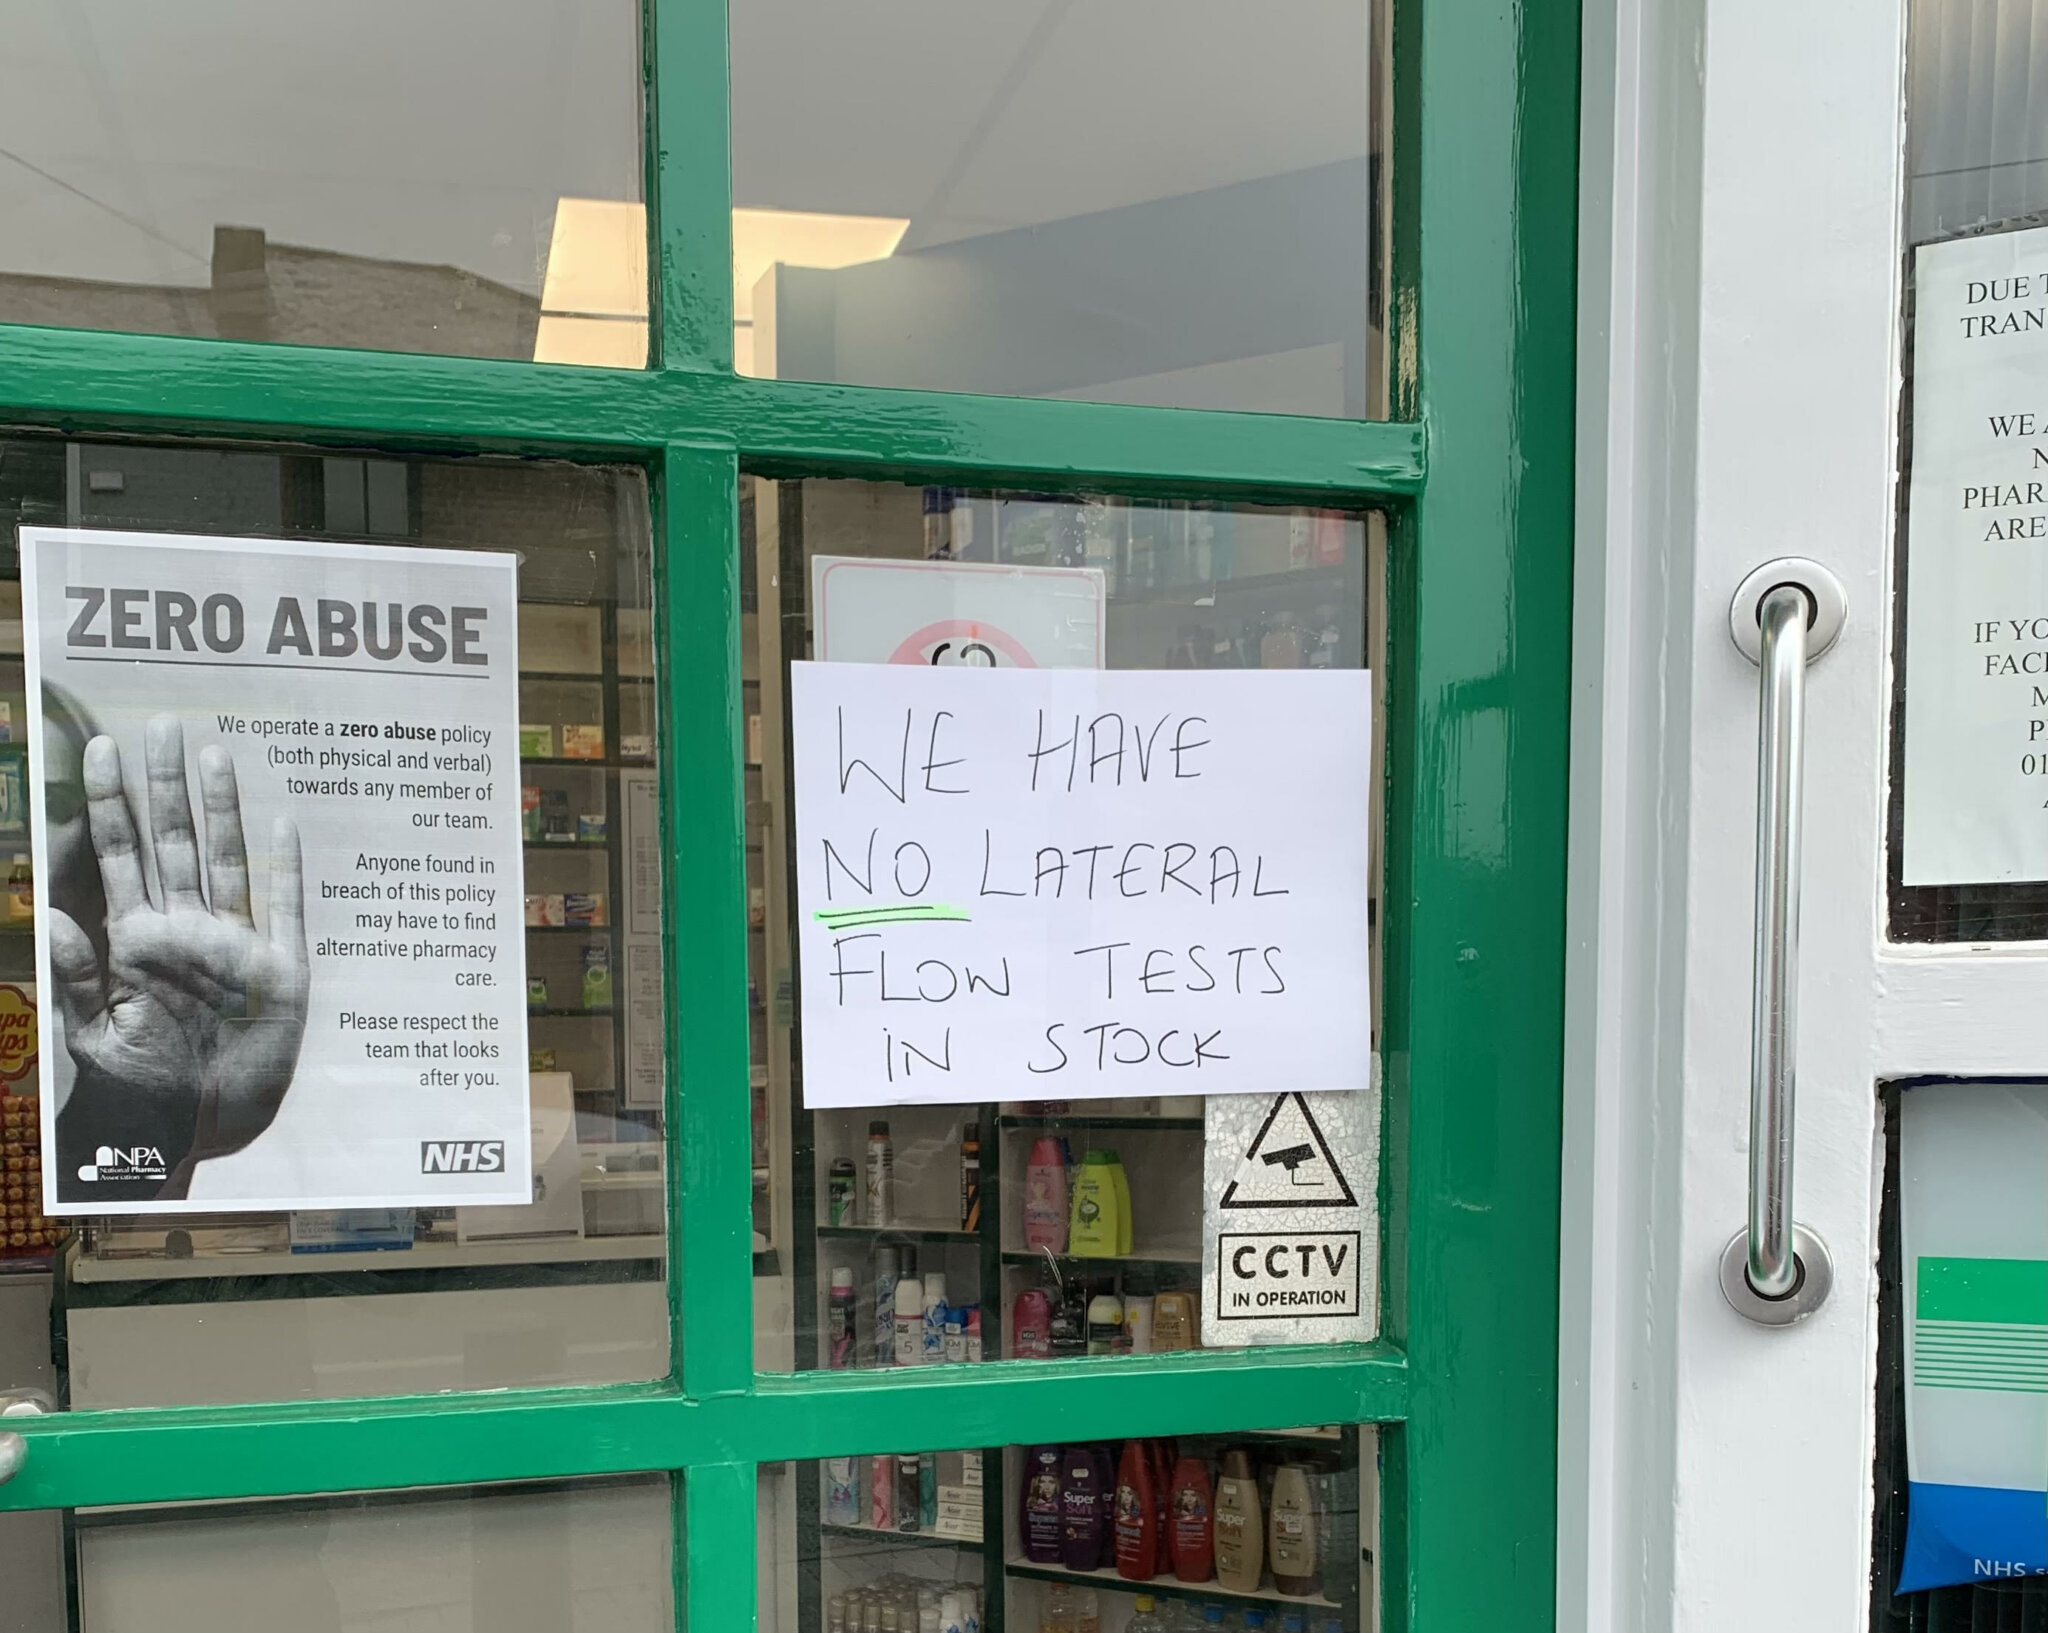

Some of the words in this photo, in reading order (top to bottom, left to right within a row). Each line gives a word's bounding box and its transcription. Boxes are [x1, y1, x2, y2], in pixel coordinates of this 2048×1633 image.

[1966, 276, 2031, 304] DUE
[1960, 307, 2046, 338] TRAN
[1988, 413, 2036, 438] WE
[1984, 516, 2047, 541] ARE
[65, 586, 244, 653] ZERO
[266, 597, 488, 665] ABUSE
[1973, 621, 2000, 643] IF
[2008, 618, 2048, 640] YO
[1984, 651, 2048, 675] FAC
[217, 715, 245, 733] We
[251, 719, 319, 738] operate
[324, 723, 335, 736] a
[340, 722, 379, 739] zero
[384, 721, 436, 741] abuse
[441, 725, 491, 748] policy
[2028, 719, 2048, 741] P
[267, 744, 314, 768] (both
[320, 746, 391, 770] physical
[397, 751, 428, 769] and
[433, 753, 492, 776] verbal)
[838, 706, 970, 803] WE
[1027, 709, 1211, 792] HAVE
[287, 776, 358, 796] towards
[364, 781, 394, 800] any
[400, 782, 470, 800] member
[475, 783, 493, 800] of
[412, 812, 440, 828] our
[445, 811, 493, 829] team.
[356, 853, 420, 875] Anyone
[426, 854, 474, 873] found
[480, 857, 495, 874] in
[822, 827, 931, 900] NO
[980, 829, 1289, 904] LATERAL
[322, 881, 381, 899] breach
[387, 882, 405, 899] of
[410, 882, 440, 901] this
[446, 884, 496, 906] policy
[356, 914, 392, 932] may
[398, 911, 437, 929] have
[443, 913, 459, 929] to
[465, 912, 496, 930] find
[316, 938, 408, 957] alternative
[413, 940, 496, 962] pharmacy
[455, 972, 496, 987] care.
[829, 934, 1010, 1005] FLOW
[1074, 942, 1285, 999] TESTS
[339, 1011, 398, 1030] Please
[403, 1014, 467, 1034] respect
[472, 1013, 499, 1030] the
[365, 1042, 409, 1058] team
[414, 1041, 448, 1058] that
[453, 1040, 499, 1058] looks
[1028, 1022, 1230, 1073] STOCK
[420, 1068, 459, 1086] after
[464, 1072, 499, 1090] you.
[114, 1147, 165, 1166] NPA
[423, 1142, 502, 1173] NHS
[131, 1167, 166, 1175] Pharmacy
[1232, 1244, 1348, 1279] CCTV
[1233, 1292, 1250, 1307] IN
[1256, 1290, 1346, 1307] OPERATION
[1064, 1491, 1096, 1506] Super
[1216, 1509, 1246, 1527] Super
[1974, 1559, 2026, 1576] NHS
